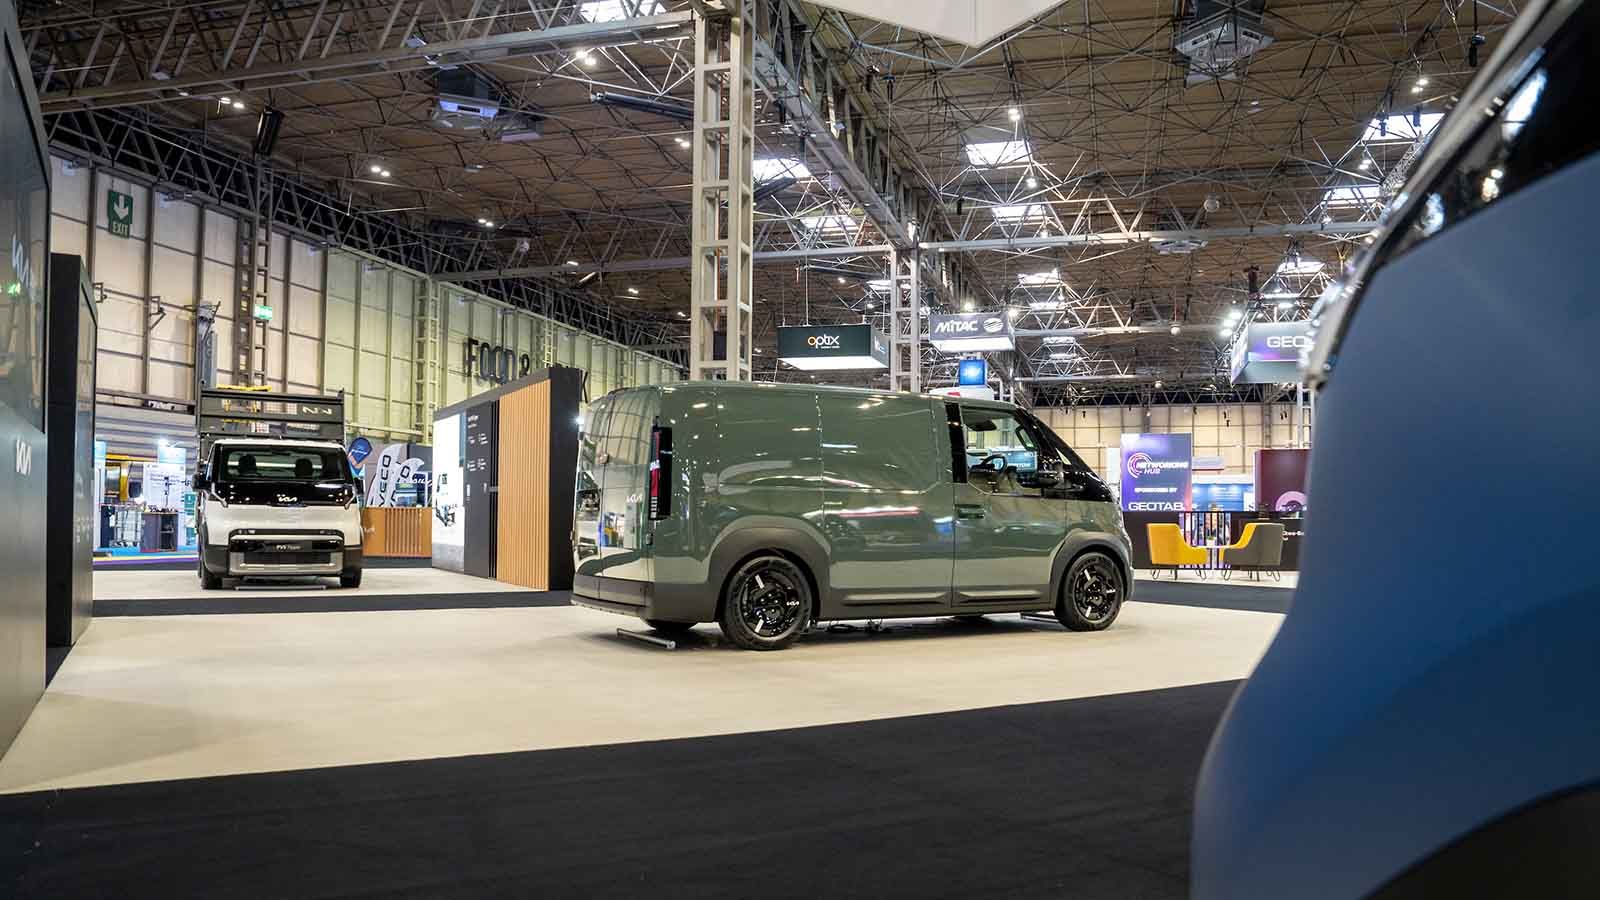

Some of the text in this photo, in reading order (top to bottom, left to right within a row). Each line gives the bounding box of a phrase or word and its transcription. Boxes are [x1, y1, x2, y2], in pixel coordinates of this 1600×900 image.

[112, 221, 129, 237] EXIT
[807, 333, 840, 349] optix
[1266, 335, 1312, 348] GEO
[466, 337, 516, 385] FOOD
[378, 454, 392, 508] VECO
[1128, 501, 1184, 511] GEOTAB
